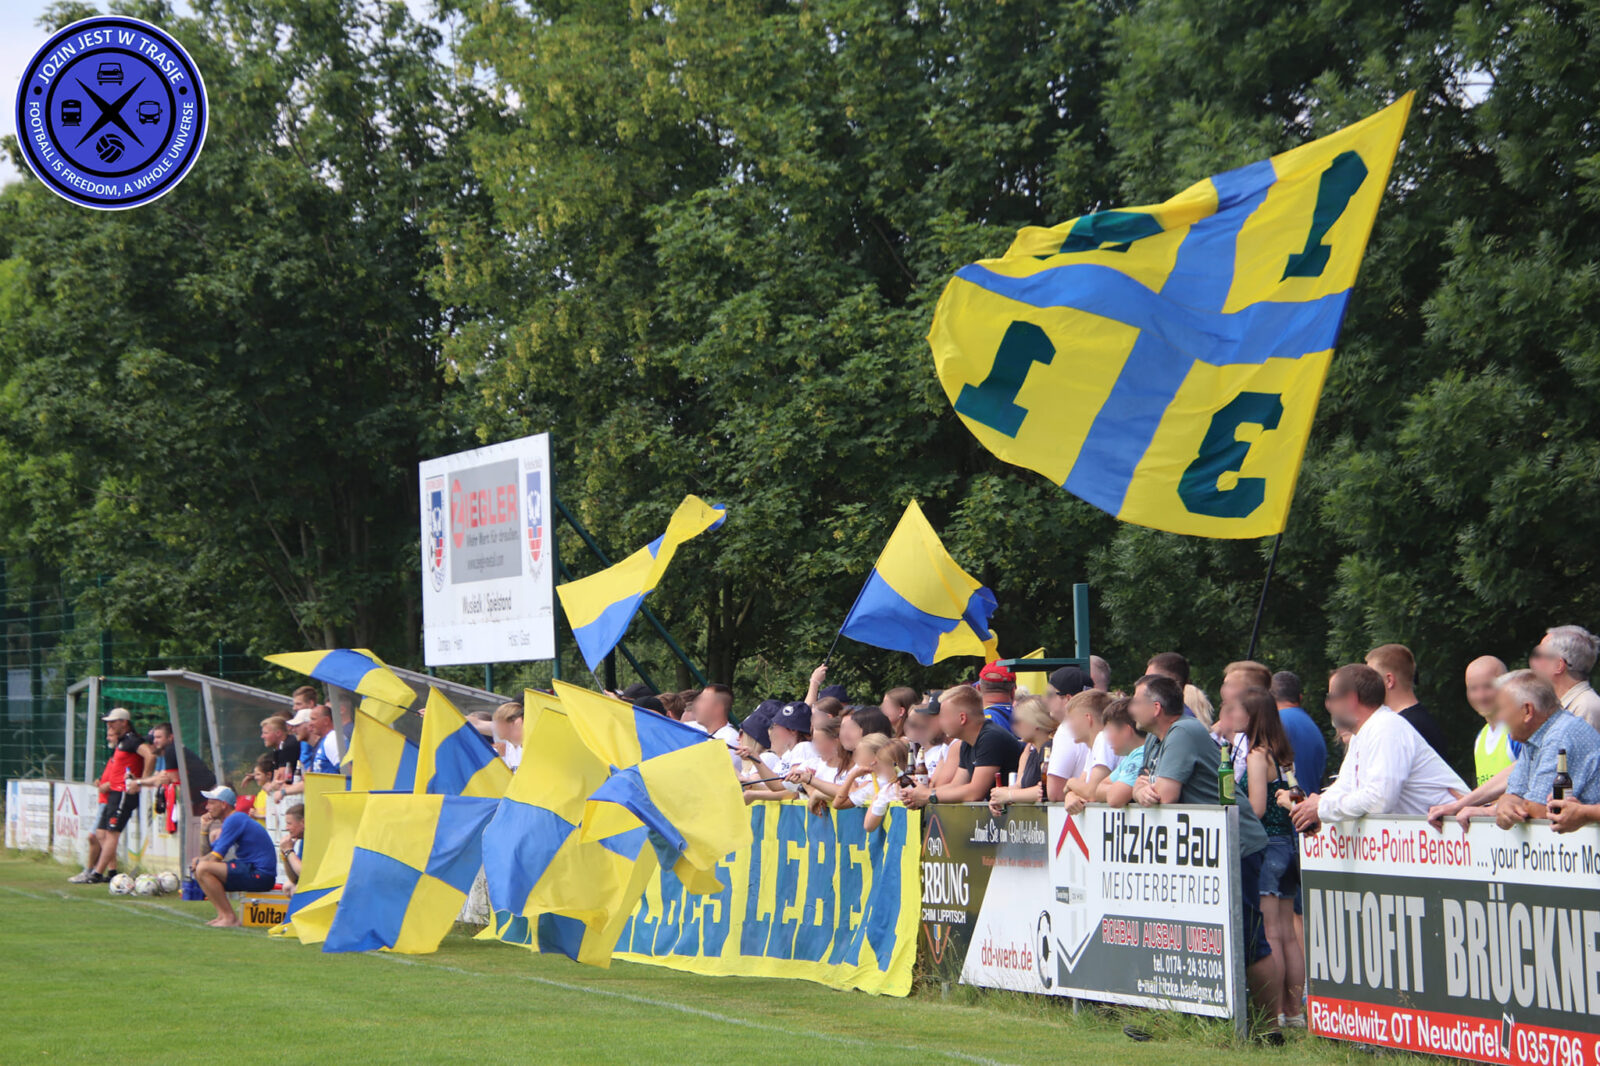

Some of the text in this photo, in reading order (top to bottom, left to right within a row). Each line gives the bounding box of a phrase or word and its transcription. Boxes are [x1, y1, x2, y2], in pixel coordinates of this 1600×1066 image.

[452, 483, 519, 535] ZIEGLER
[1103, 812, 1220, 868] Hitzke Bau
[1303, 826, 1416, 863] Car-Service-Point
[1419, 829, 1472, 866] Bensch
[1491, 847, 1519, 875] your
[1522, 841, 1557, 872] Point
[1558, 843, 1578, 873] for
[1102, 871, 1221, 905] MEISTERBETRIEB
[938, 908, 966, 924] LIPPITSCH
[1102, 918, 1222, 956] ROHBAU AUSBAU UMBAU
[981, 938, 1033, 971] dd-werb.de
[1309, 888, 1426, 993] AUTOFIT
[1153, 954, 1164, 972] tel.
[1165, 955, 1181, 974] 0174
[1208, 961, 1222, 979] 004
[1311, 1000, 1389, 1043] Räckelwitz
[1391, 1012, 1412, 1046] OT
[1417, 1015, 1500, 1059] Neudörfel
[1517, 1030, 1584, 1066] 035796
